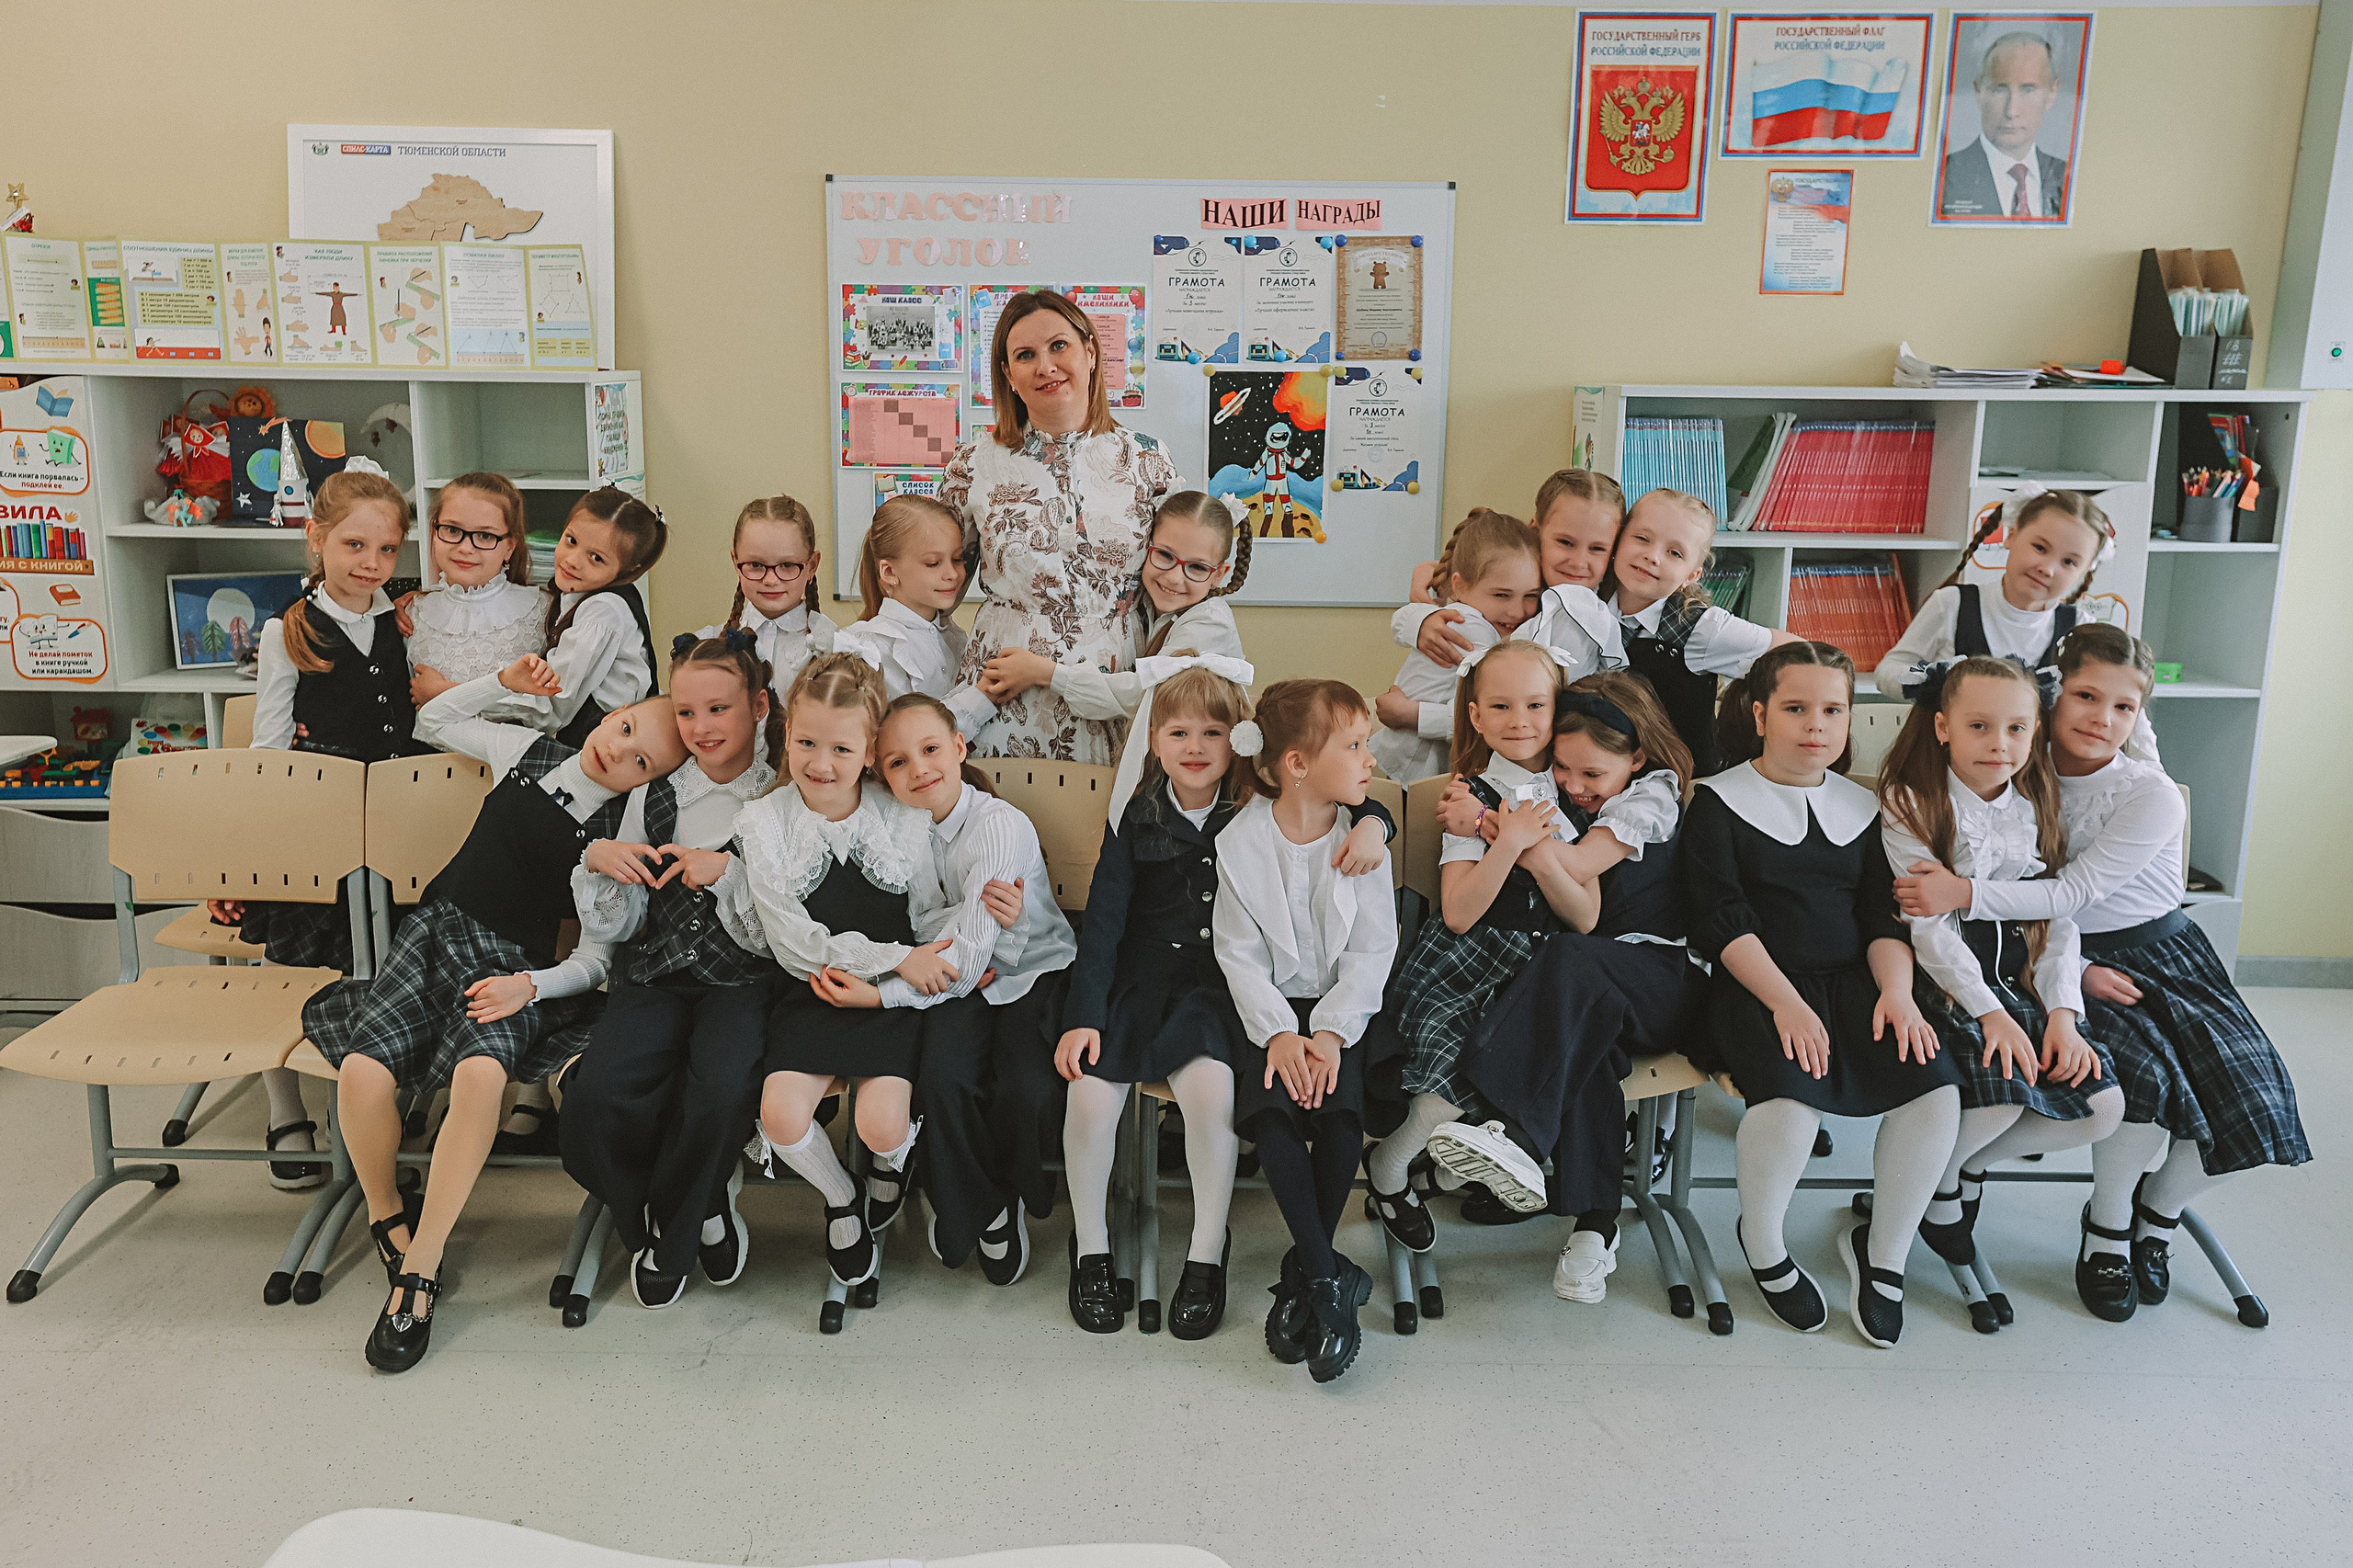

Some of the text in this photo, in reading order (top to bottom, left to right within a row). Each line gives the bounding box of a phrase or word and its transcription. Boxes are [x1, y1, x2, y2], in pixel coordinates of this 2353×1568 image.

[1591, 28, 1701, 41] ГОСУДАРСТВЕННЫЙ ГЕРБ
[1776, 24, 1860, 37] ГОСУДАРСТВЕННЫЙ
[1774, 38, 1885, 52] РОССИЙСКОЙ ФЕДЕРАЦИИ
[1590, 44, 1700, 58] РОССИЙСКОЙ ФЕДЕРАЦИИ
[398, 145, 460, 156] ТЮМЕНСКОЙ
[461, 147, 506, 157] ОБЛАСТИ
[840, 190, 1074, 223] КЛАССНЫЙ
[1202, 199, 1381, 229] НАШИ НАГРАДЫ
[857, 236, 1031, 267] УГОЛОК
[1168, 277, 1225, 287] ГРАМОТА
[1259, 277, 1316, 287] ГРАМОТА
[1349, 407, 1405, 417] ГРАМОТА
[40, 473, 79, 483] порвалась
[21, 481, 52, 489] подклей
[30, 560, 84, 571] КНИГОЙ
[39, 650, 61, 658] делай
[63, 659, 88, 667] ручкой
